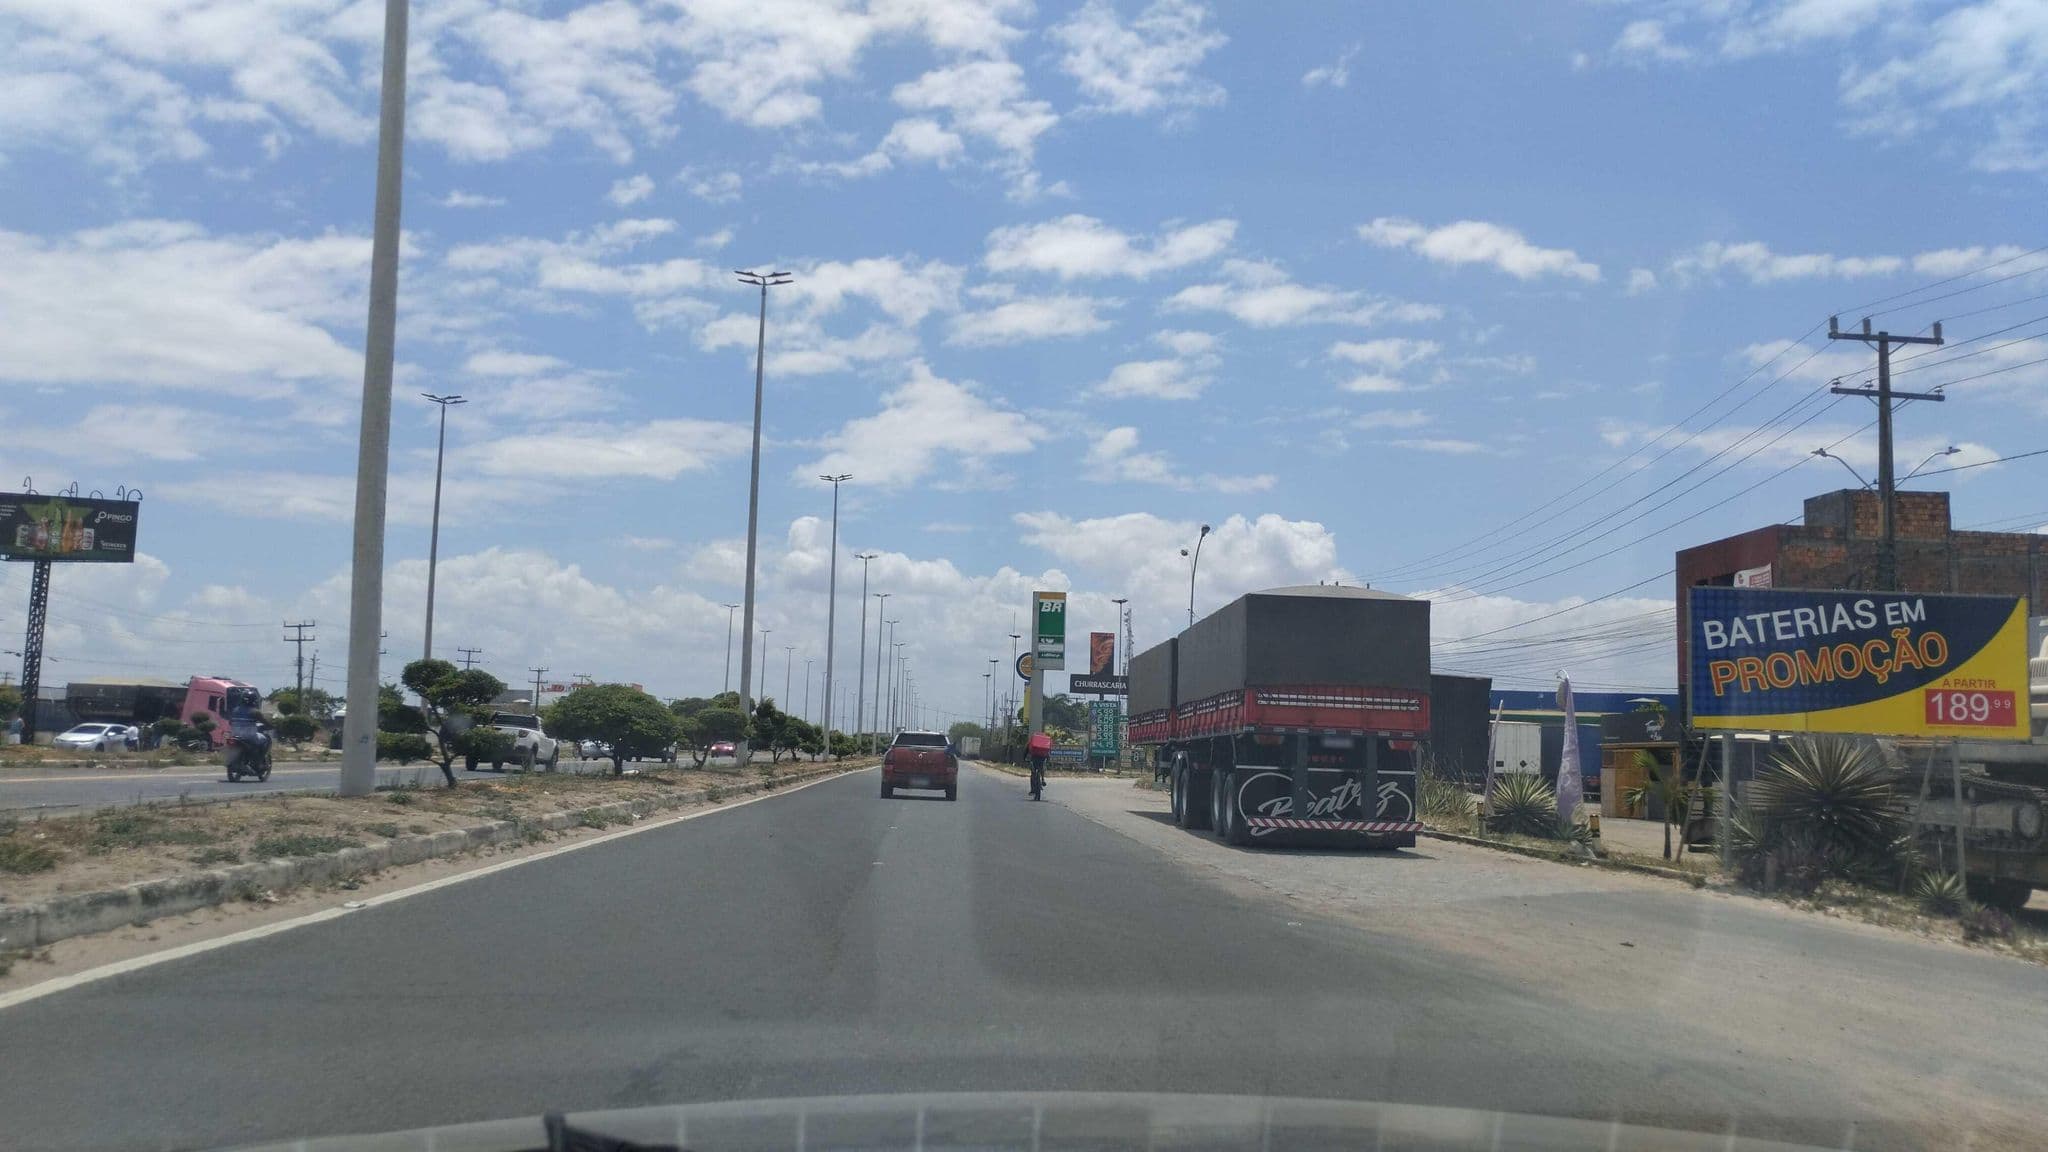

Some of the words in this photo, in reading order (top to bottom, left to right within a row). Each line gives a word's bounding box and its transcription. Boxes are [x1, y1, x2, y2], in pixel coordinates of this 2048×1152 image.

[1041, 602, 1063, 613] BR
[1703, 599, 1877, 650] BATERIAS
[1884, 599, 1926, 627] EM
[1709, 627, 1948, 697] PROMOÇÃO
[1074, 680, 1127, 689] CHURRASCARIA
[1953, 679, 1996, 689] PARTIR
[1931, 692, 1989, 722] 189
